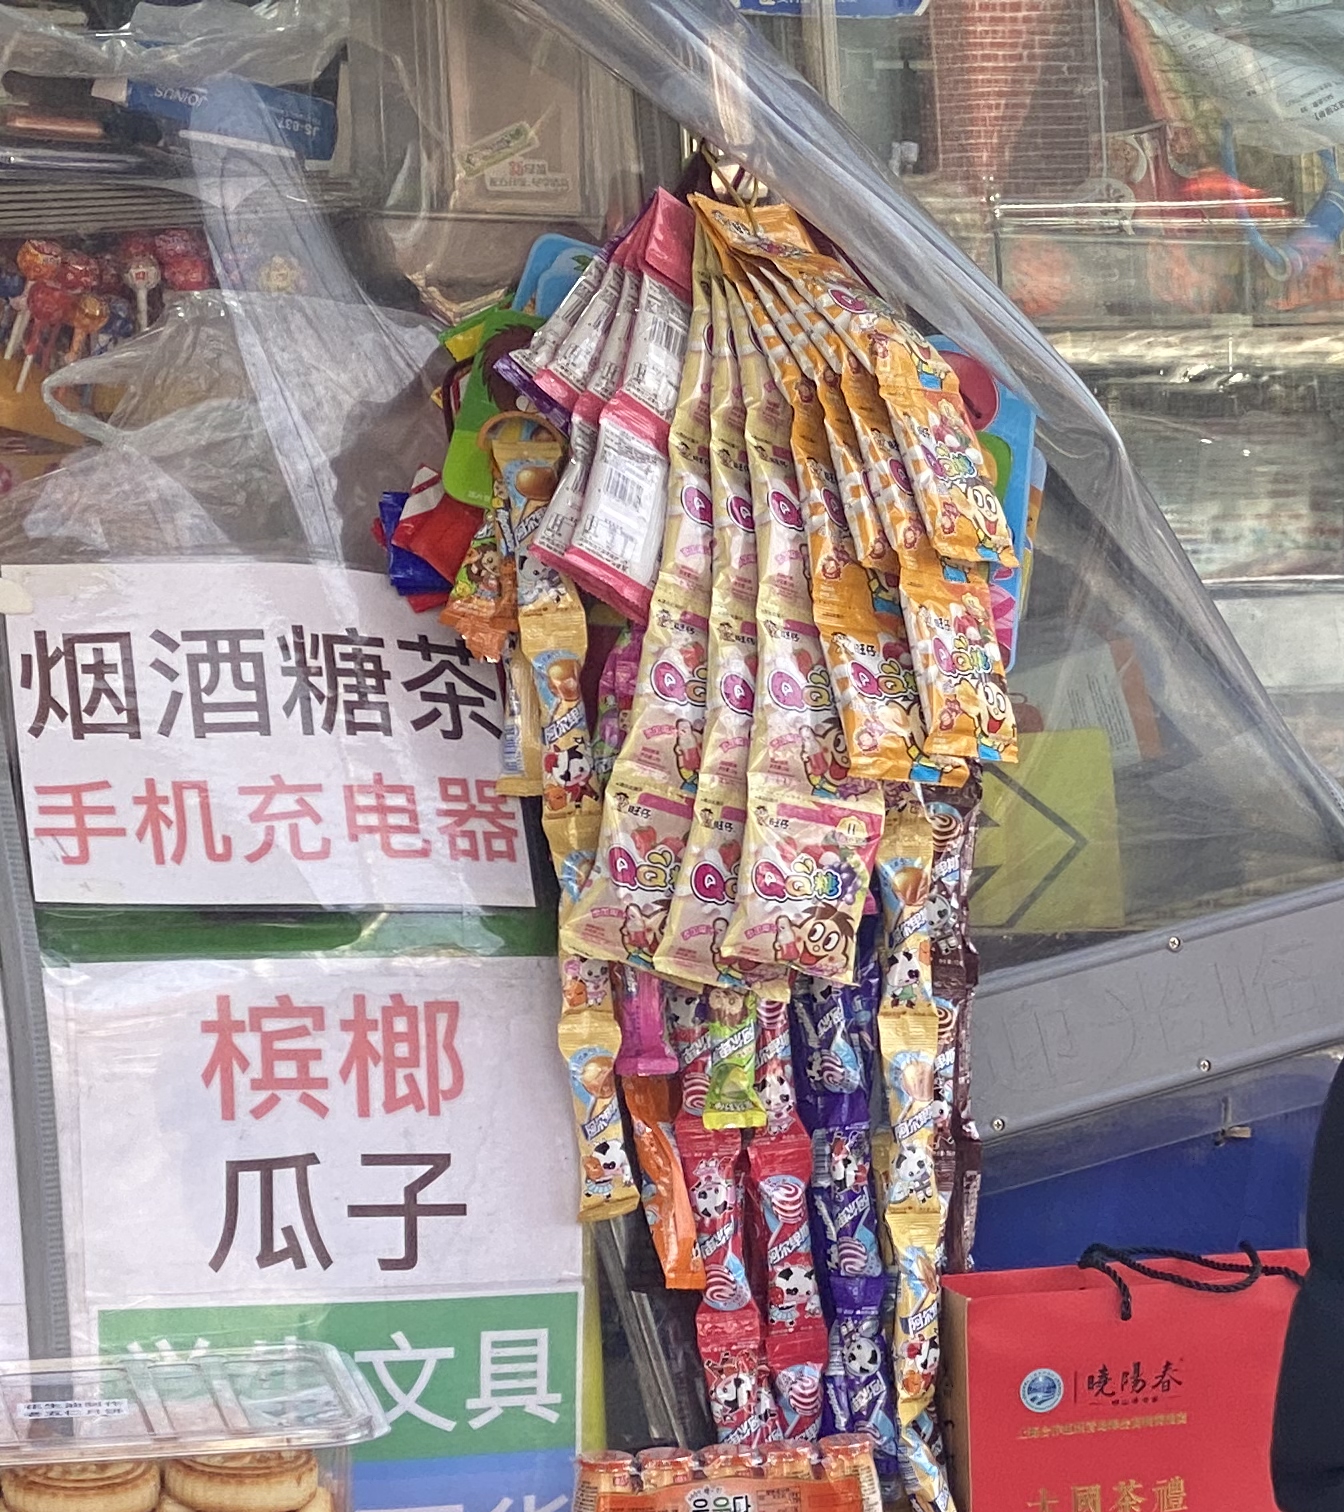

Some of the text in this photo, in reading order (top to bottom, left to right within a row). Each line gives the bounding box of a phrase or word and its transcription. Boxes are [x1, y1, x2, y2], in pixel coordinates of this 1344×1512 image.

[20, 625, 503, 740] 烟酒糖茶
[34, 772, 518, 866] 手机充电器
[200, 993, 465, 1121] 槟榔
[208, 1152, 468, 1273] 瓜子
